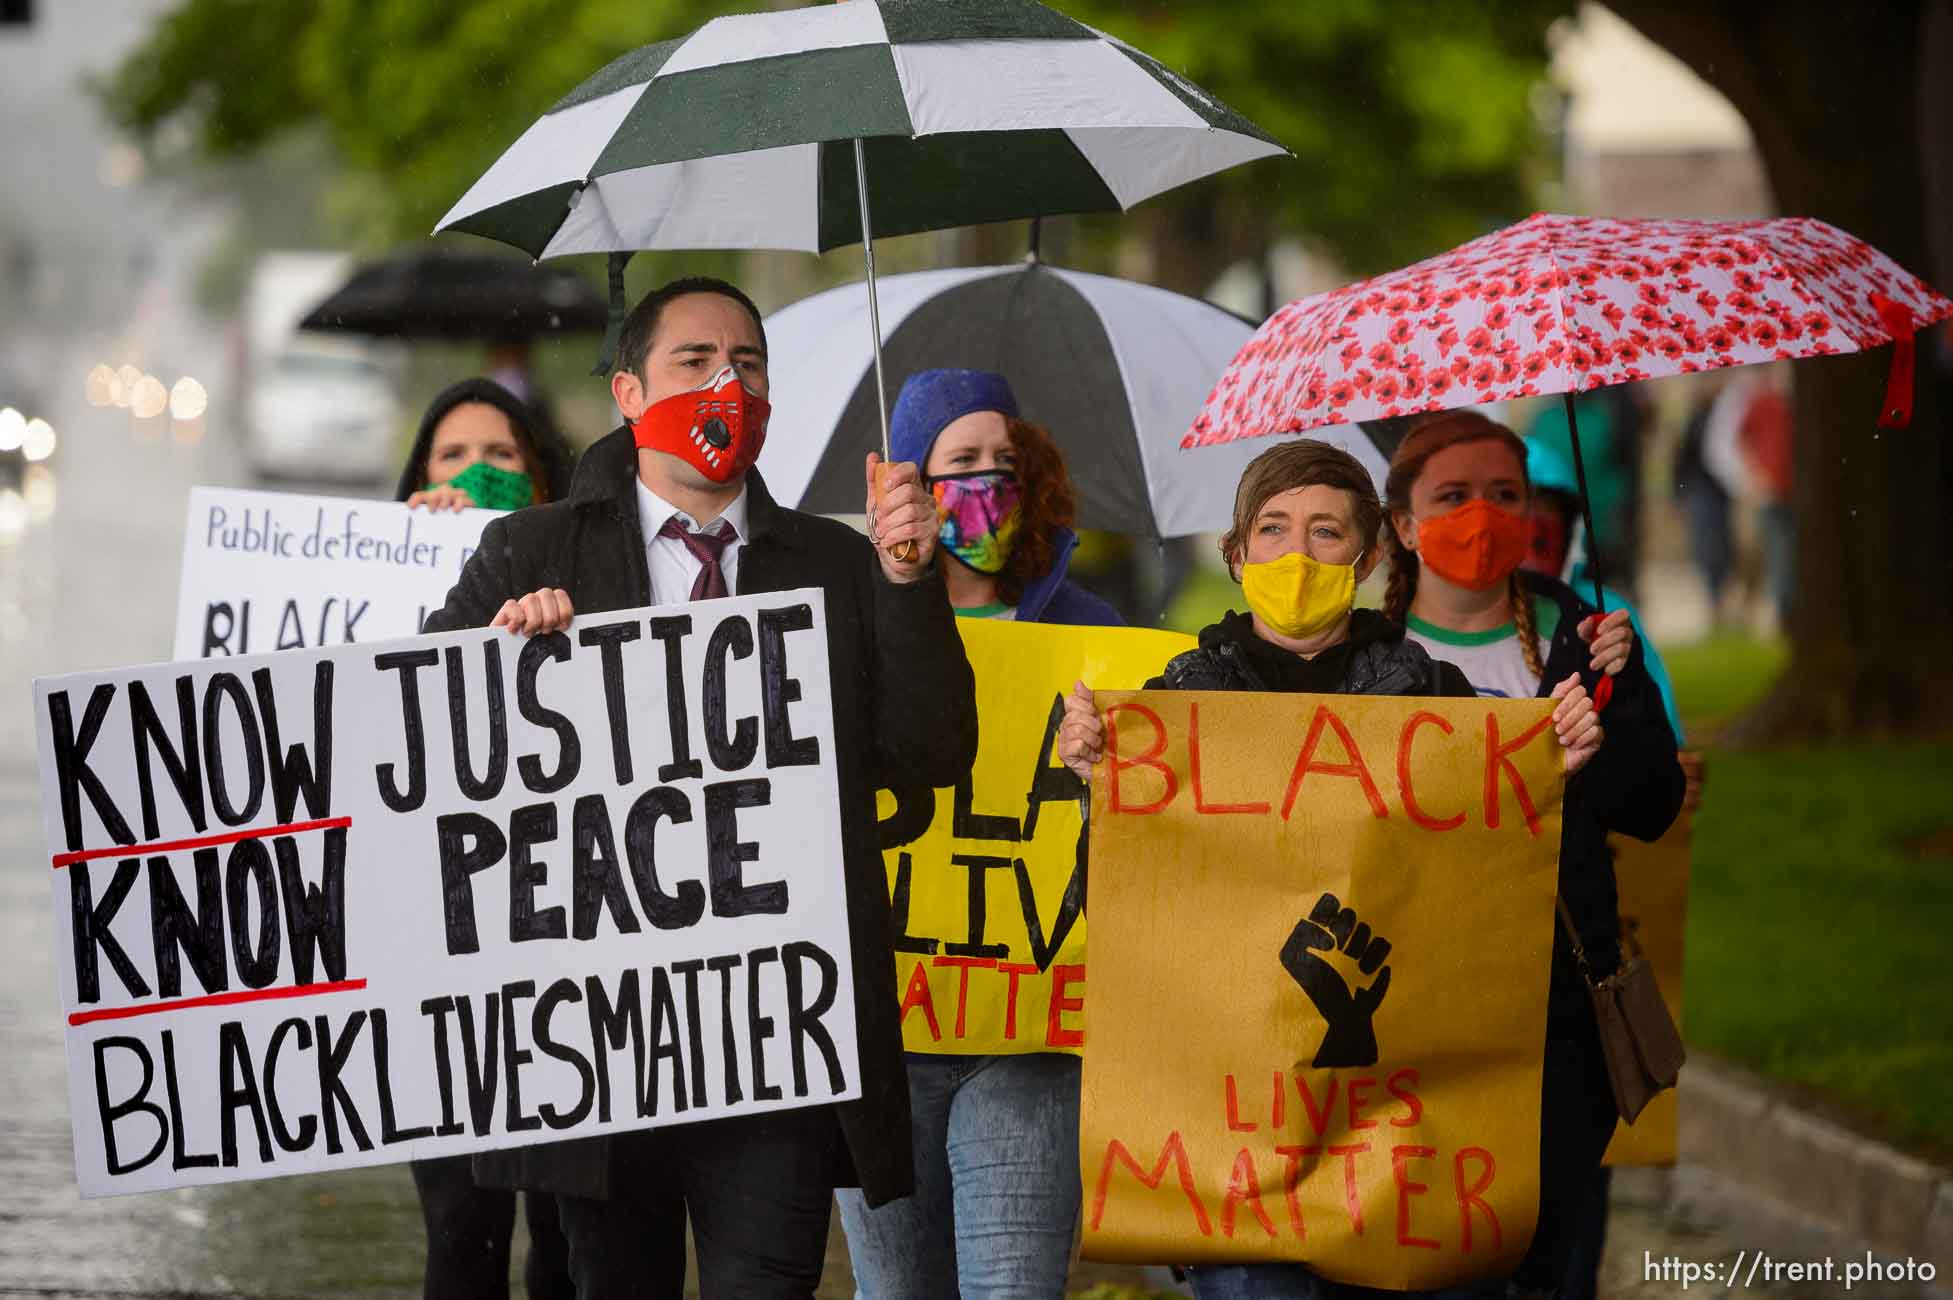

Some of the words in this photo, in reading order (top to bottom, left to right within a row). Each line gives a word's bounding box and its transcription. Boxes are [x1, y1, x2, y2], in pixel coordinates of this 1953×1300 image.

[206, 505, 293, 559] Public
[302, 507, 443, 569] defender
[48, 660, 334, 851] KNOW
[375, 604, 821, 812] JUSTICE
[1106, 701, 1554, 839] BLACK
[70, 827, 349, 1004] KNOW
[437, 778, 789, 956] PEACE
[1224, 1067, 1424, 1137] LIVES
[1091, 1130, 1503, 1256] MATTER
